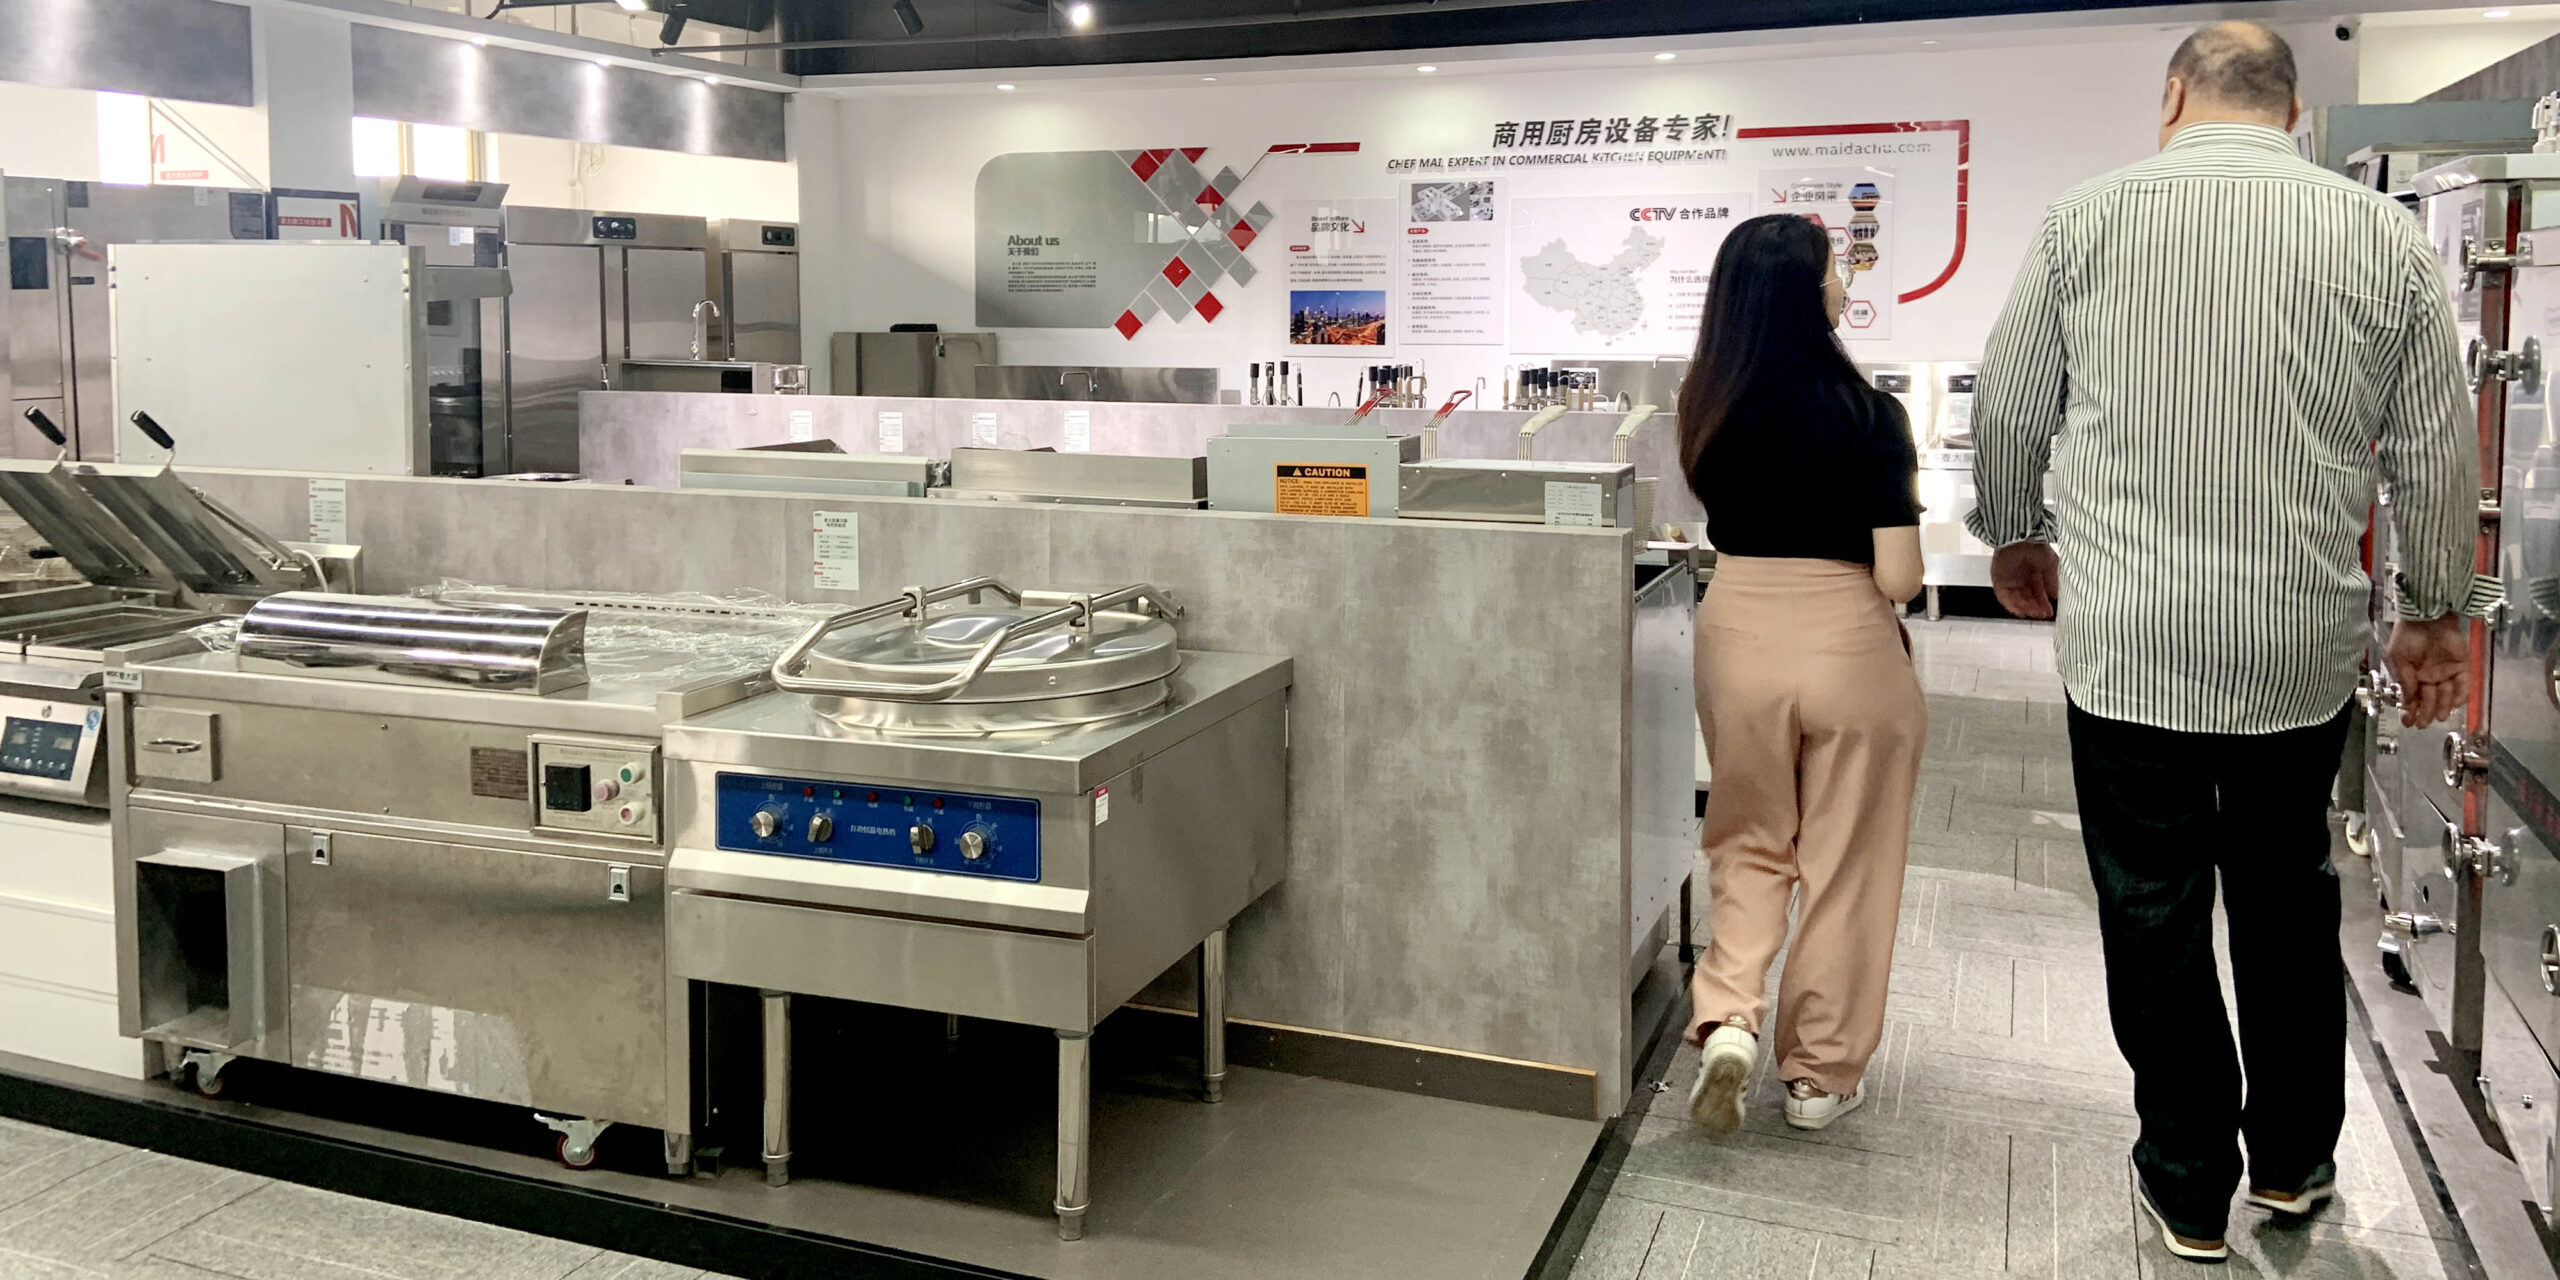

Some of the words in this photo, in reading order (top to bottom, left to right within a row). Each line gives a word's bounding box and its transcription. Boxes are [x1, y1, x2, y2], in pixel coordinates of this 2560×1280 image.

[1492, 113, 1730, 148] 商用厨房设备专家!
[1387, 158, 1416, 169] CHEF
[1448, 156, 1490, 167] EXPERT
[1492, 155, 1506, 166] IN
[1509, 152, 1588, 165] COMMERCIAL
[1592, 151, 1645, 163] KITCHEN
[1648, 148, 1727, 162] EQUIPMENT!
[1629, 207, 1677, 221] CCTV
[1679, 206, 1730, 220] 合作品牌
[1311, 222, 1350, 232] 品牌文化
[1007, 235, 1043, 246] About
[1045, 236, 1060, 246] us
[1007, 247, 1039, 256] 关于我们
[1304, 467, 1351, 477] CAUTION
